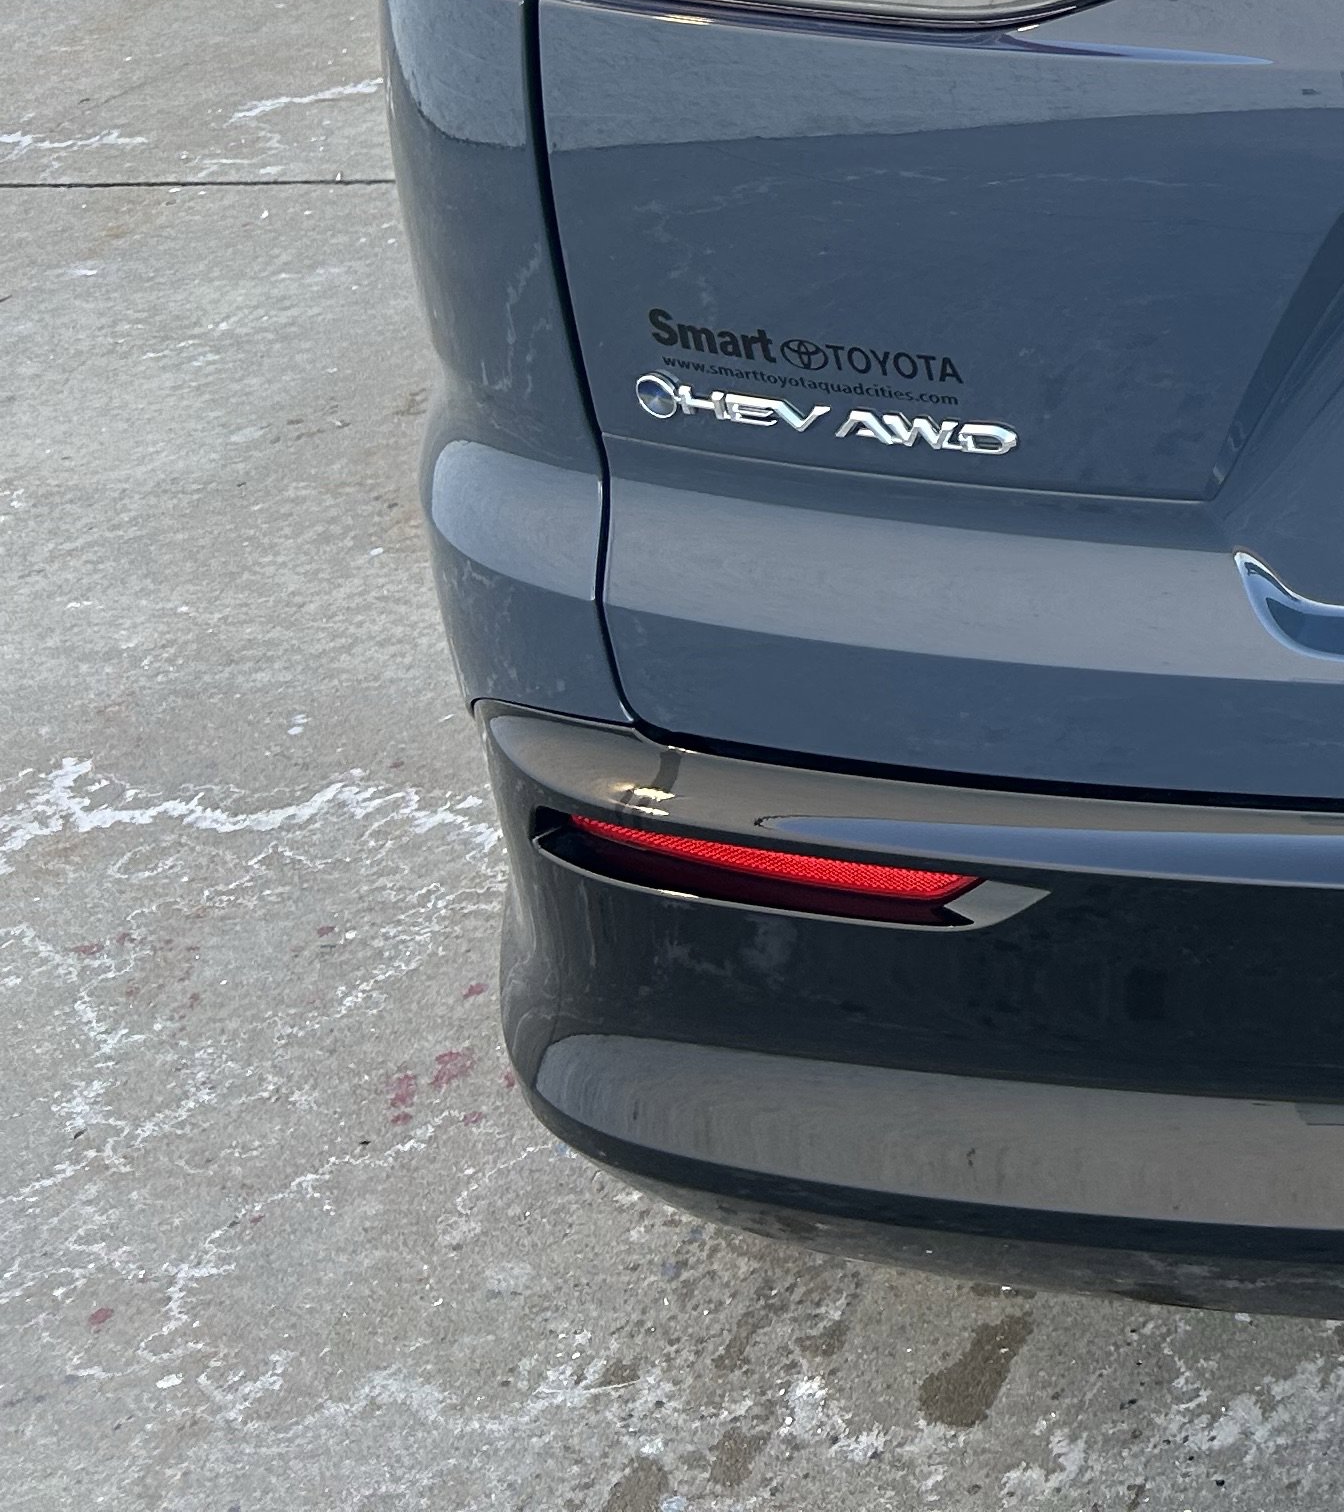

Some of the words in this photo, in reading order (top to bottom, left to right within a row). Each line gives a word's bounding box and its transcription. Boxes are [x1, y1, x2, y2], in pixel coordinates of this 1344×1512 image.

[648, 308, 777, 364] Smart
[825, 343, 964, 384] TOYOTA
[662, 355, 959, 406] www.smarttoyotaquadcities.com
[675, 384, 831, 432] HEV
[834, 406, 1018, 455] AWD
